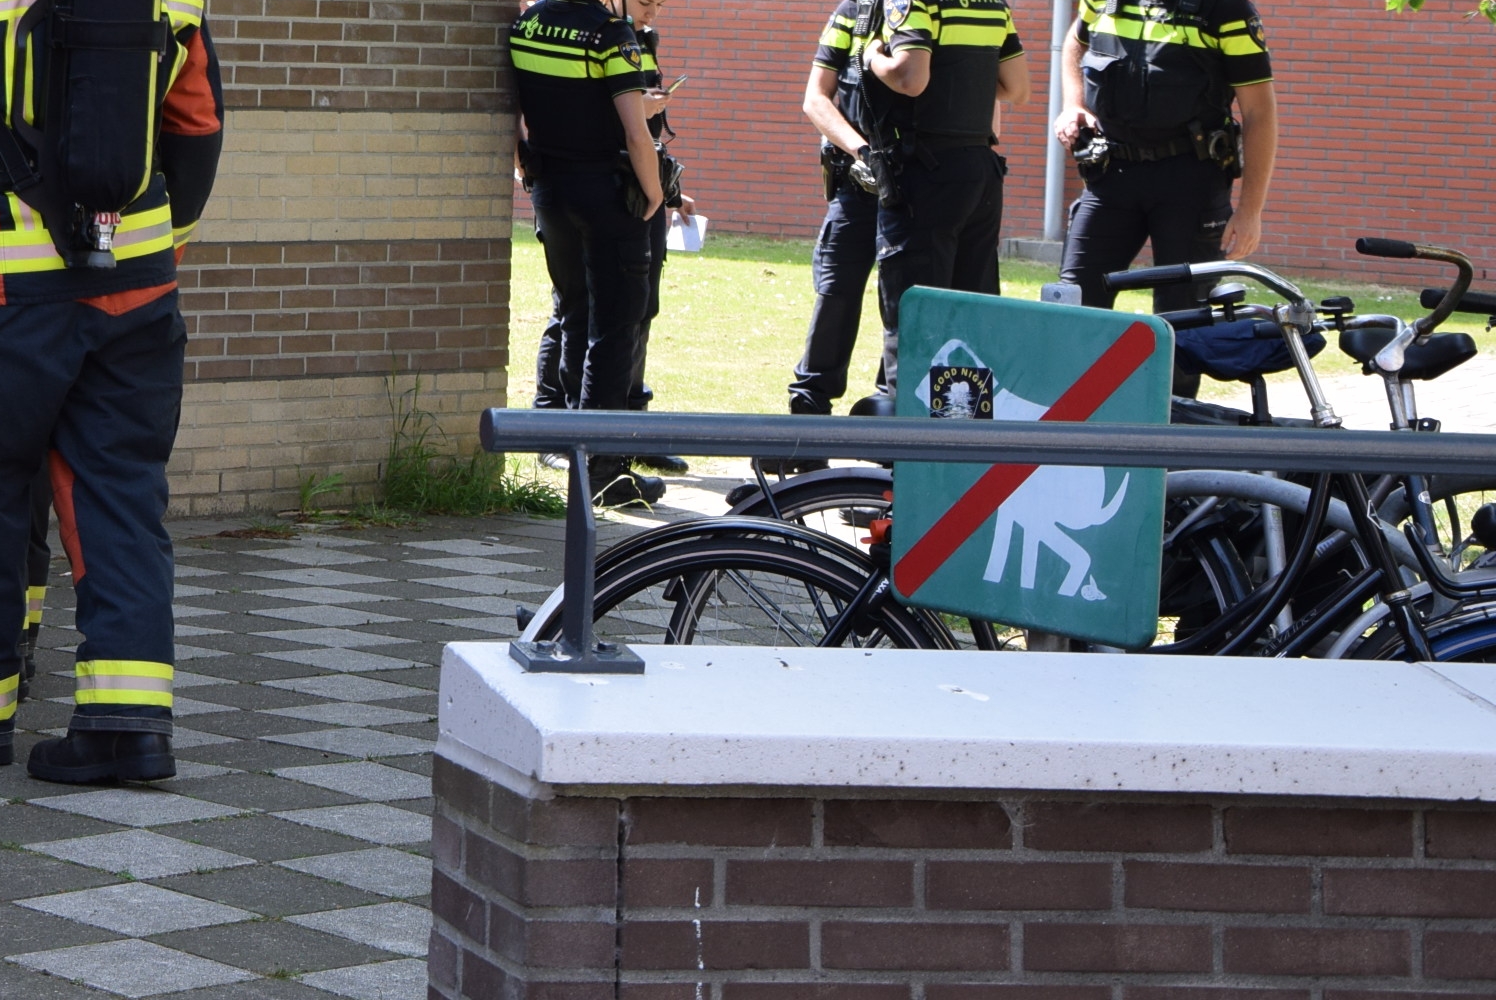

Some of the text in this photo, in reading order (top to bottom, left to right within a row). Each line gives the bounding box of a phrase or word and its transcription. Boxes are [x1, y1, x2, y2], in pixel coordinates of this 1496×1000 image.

[519, 14, 579, 41] POLITIE
[933, 368, 988, 395] GOOD NIGHT
